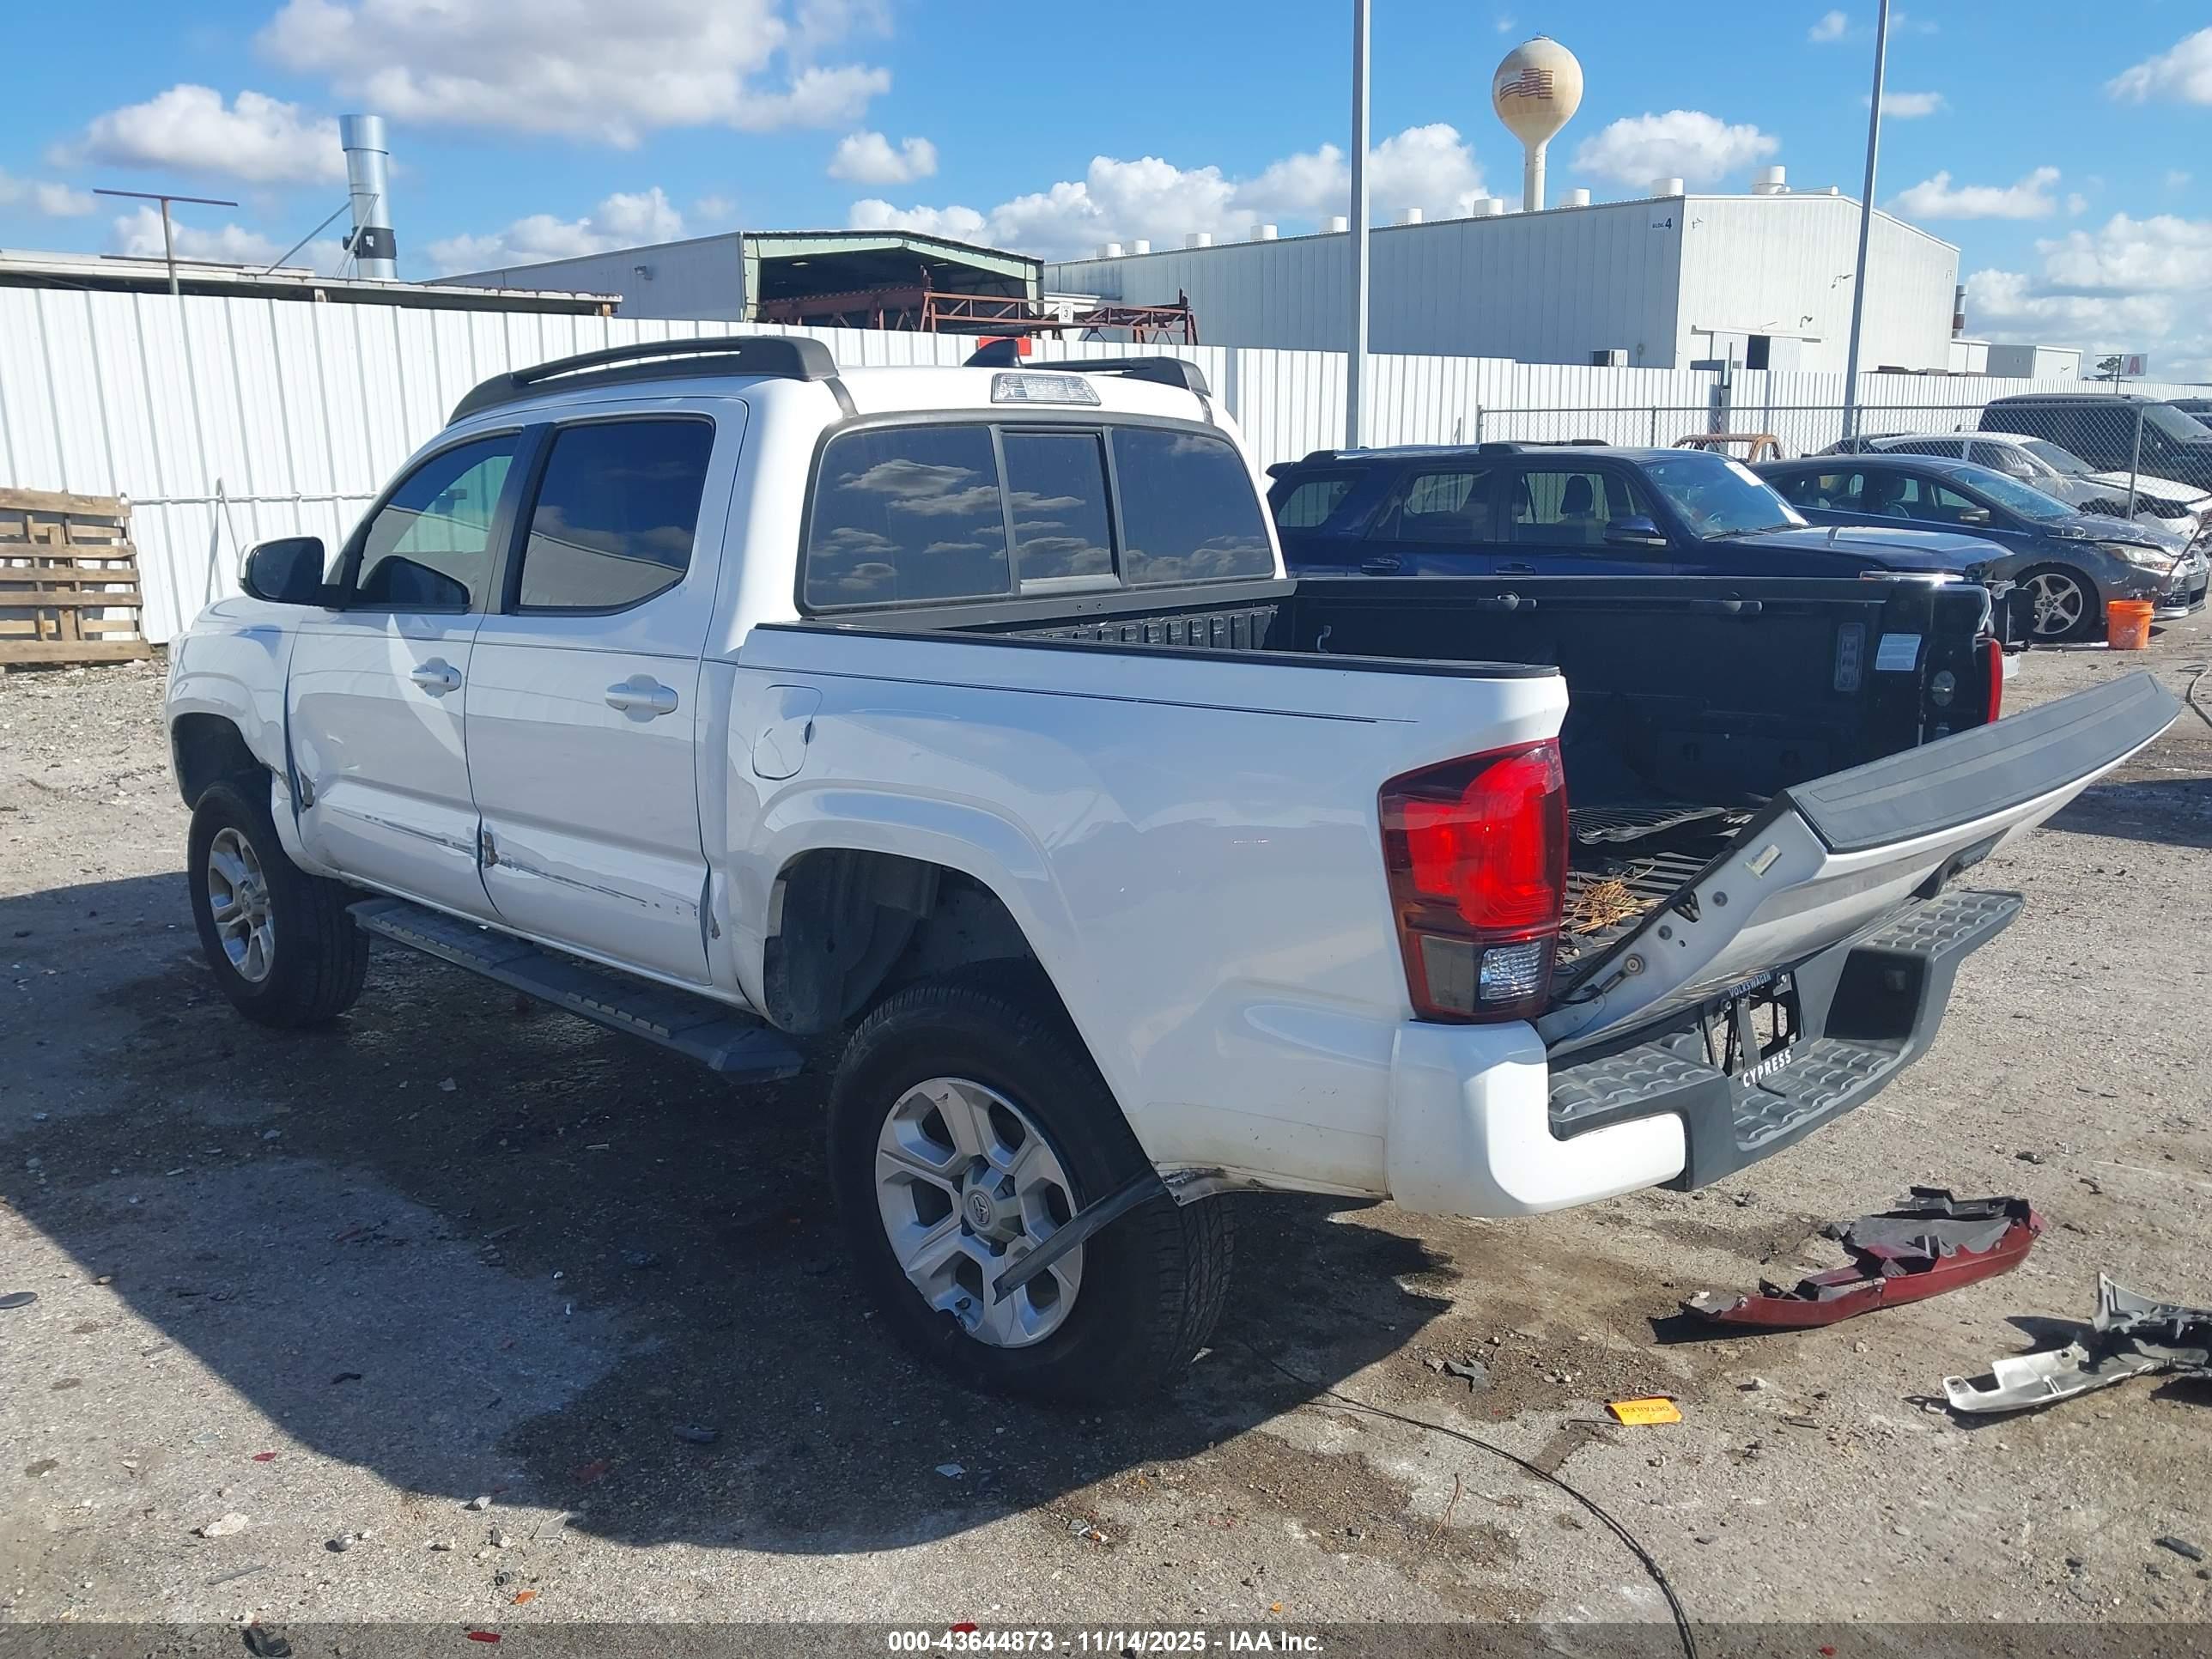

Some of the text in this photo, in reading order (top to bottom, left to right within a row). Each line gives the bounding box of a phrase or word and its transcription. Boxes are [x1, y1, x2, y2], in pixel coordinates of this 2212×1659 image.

[1665, 217, 1673, 230] 4
[1063, 309, 1069, 318] 3
[2128, 356, 2141, 374] A
[1728, 970, 1771, 998] VOLKSWAGEN
[1742, 1048, 1793, 1088] CYPRESS
